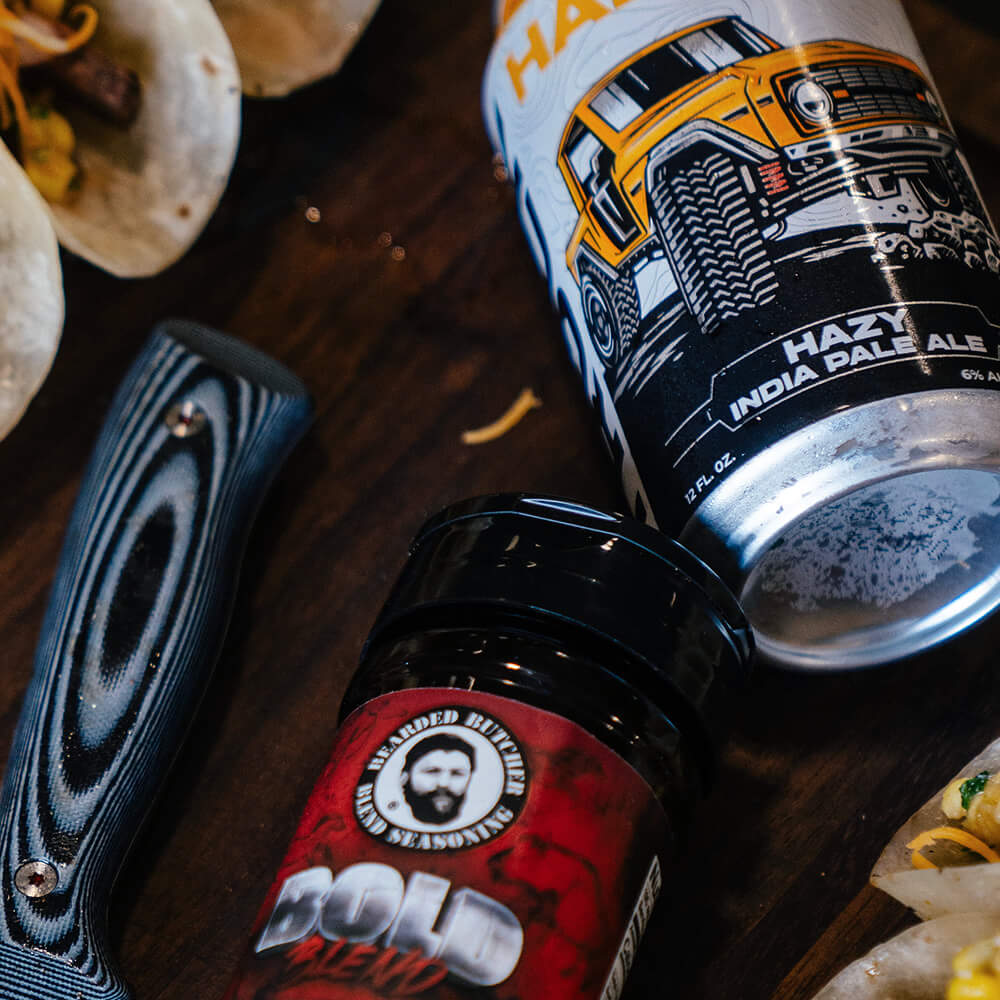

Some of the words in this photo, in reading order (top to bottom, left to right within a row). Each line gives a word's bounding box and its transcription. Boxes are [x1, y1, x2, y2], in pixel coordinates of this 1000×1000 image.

[505, 0, 631, 106] HA
[782, 308, 909, 365] HAZY
[961, 368, 985, 381] 6%
[728, 364, 819, 422] INDIA
[823, 336, 919, 374] PALE
[926, 332, 988, 353] ALE
[684, 487, 697, 505] 12
[695, 473, 715, 493] FL.
[714, 451, 737, 474] OZ.
[367, 709, 460, 771] BEARDED
[464, 711, 527, 797] BUTCHER
[354, 782, 389, 836] BLEND
[386, 804, 515, 851] SEASONING
[255, 861, 525, 988] BOLD
